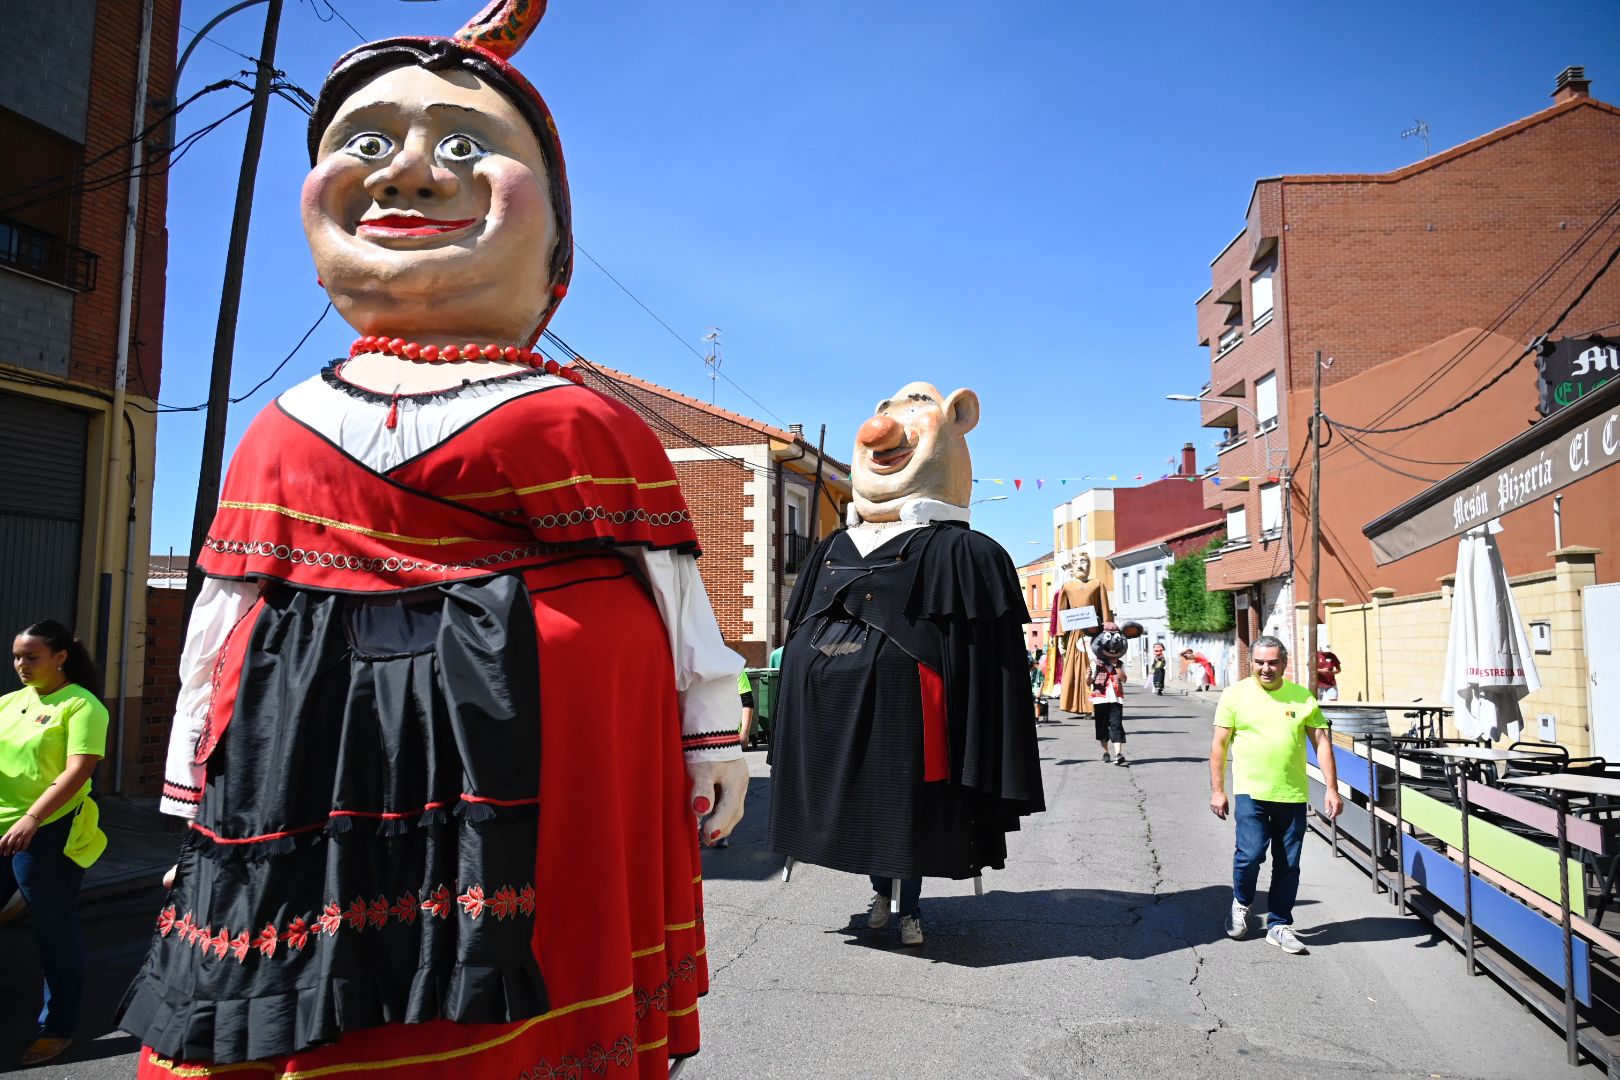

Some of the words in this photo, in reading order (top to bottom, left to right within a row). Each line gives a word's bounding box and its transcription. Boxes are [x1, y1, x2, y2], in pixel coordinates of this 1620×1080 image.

[1453, 486, 1489, 530] Mesón
[1497, 451, 1553, 511] Pizzería
[1569, 427, 1590, 472] El
